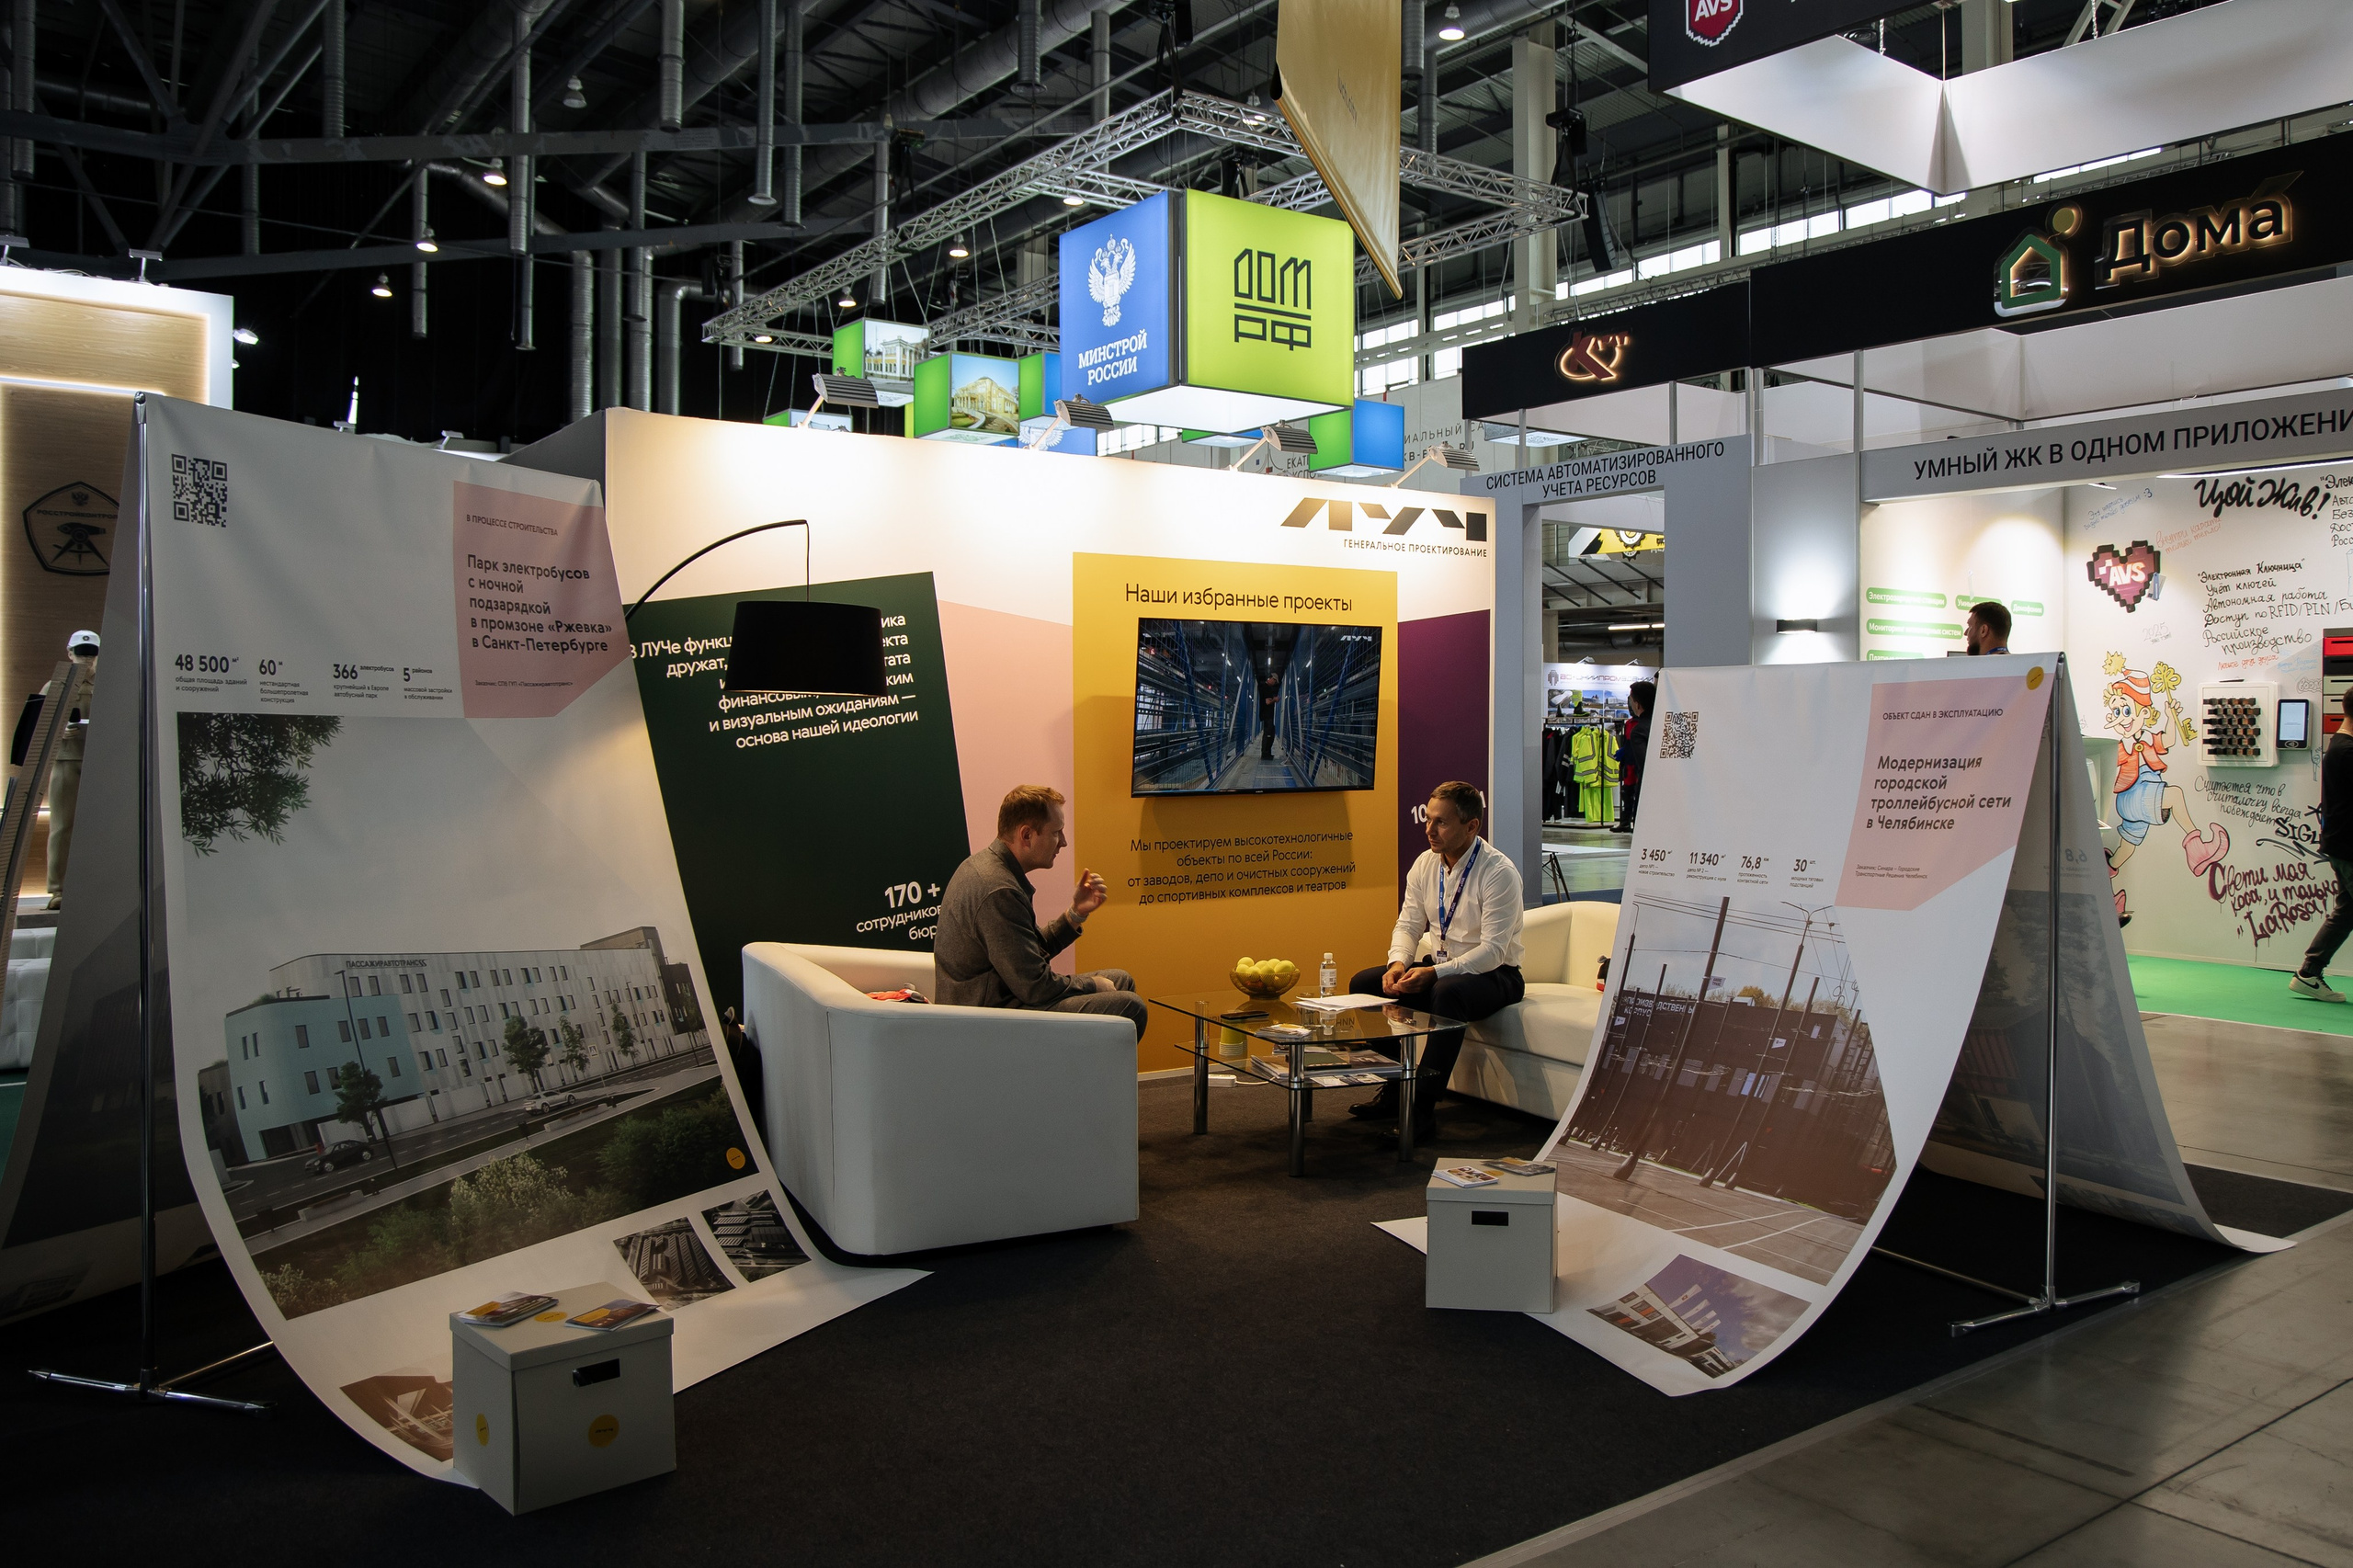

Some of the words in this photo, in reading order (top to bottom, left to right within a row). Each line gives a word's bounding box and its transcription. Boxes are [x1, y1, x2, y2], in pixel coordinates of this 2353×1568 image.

[1694, 0, 1733, 22] AVS
[2108, 199, 2286, 277] Дома
[1234, 248, 1312, 310] ДОМ
[1234, 313, 1312, 351] РФ
[1078, 328, 1148, 369] МИНСТРОЙ
[1087, 356, 1138, 386] РОССИИ
[1486, 468, 1545, 490] СИСТЕМА
[1547, 441, 1724, 481] АВТОМАТИЗИРОВАННОГО
[1914, 448, 1998, 481] УМНЫЙ
[2004, 445, 2043, 470] ЖК
[2049, 443, 2064, 464] В
[2070, 430, 2165, 463] ОДНОМ
[1541, 479, 1583, 499] УЧЕТА
[1586, 470, 1656, 494] РЕСУРСОВ
[2193, 476, 2256, 518] Цой
[2256, 477, 2331, 520] Жив!
[466, 514, 471, 522] В
[472, 515, 507, 528] ПРОЦЕССЕ
[508, 520, 559, 537] СТРОИТЕЛЬСТВА
[1343, 539, 1406, 552] ГЕНЕРАЛЬНОЕ
[1408, 542, 1488, 558] ПРОЕКТИРОВАНИЕ
[467, 553, 499, 574] Парк
[502, 561, 590, 583] электробусов
[2109, 562, 2146, 587] AVS
[468, 576, 475, 588] с
[478, 578, 524, 594] ночной
[2235, 577, 2278, 590] ключей
[469, 597, 551, 615] подзарядкой
[1125, 583, 1177, 605] Наши
[1183, 587, 1279, 611] избранные
[1283, 595, 1353, 614] проекты
[471, 617, 477, 629] в
[481, 617, 544, 633] промзоне
[548, 619, 612, 634] «Ржевка»
[472, 637, 479, 648] в
[482, 634, 608, 654] Санкт-Петербурге
[640, 639, 682, 658] ЛУЧе
[175, 653, 194, 672] 48
[199, 654, 230, 674] 500
[258, 658, 277, 676] 60
[333, 663, 358, 680] 366
[665, 657, 728, 678] дружат,
[403, 667, 411, 683] 5
[709, 721, 720, 733] и
[722, 706, 813, 731] визуальным
[814, 694, 900, 717] ожиданиям
[1882, 711, 1909, 721] ОБЪЕКТ
[1910, 710, 1931, 720] СДАН
[1932, 710, 1938, 719] В
[1938, 708, 2004, 720] ЭКСПЛУАТАЦИЮ
[735, 730, 790, 749] основа
[791, 720, 840, 741] нашей
[842, 710, 919, 733] идеологии
[1877, 755, 1983, 773] Модернизация
[1873, 775, 1948, 793] городской
[1870, 793, 1975, 813] троллейбусной
[1978, 796, 2011, 809] сети
[1866, 818, 1873, 829] в
[1877, 814, 1955, 830] Челябинске
[1130, 838, 1151, 852] Мы
[1154, 836, 1233, 852] проектируем
[1234, 831, 1354, 846] высокотехнологичные
[1176, 854, 1225, 867] объекты
[1228, 854, 1242, 864] по
[1245, 849, 1270, 863] всей
[1272, 848, 1313, 862] России:
[1641, 848, 1648, 860] 3
[1649, 848, 1666, 862] 450
[1689, 851, 1699, 865] 11
[1699, 852, 1720, 867] 340
[1741, 855, 1762, 871] 76,8
[1793, 858, 1808, 872] 30
[1127, 876, 1141, 888] от
[1143, 872, 1193, 887] заводов,
[1195, 870, 1224, 885] депо
[1227, 871, 1234, 881] и
[1236, 868, 1289, 881] очистных
[1290, 862, 1356, 878] сооружений
[884, 881, 923, 909] 170
[1138, 893, 1154, 906] до
[1156, 889, 1227, 904] спортивных
[1228, 884, 1294, 898] комплексов
[1296, 884, 1304, 893] и
[1305, 880, 1347, 894] театров
